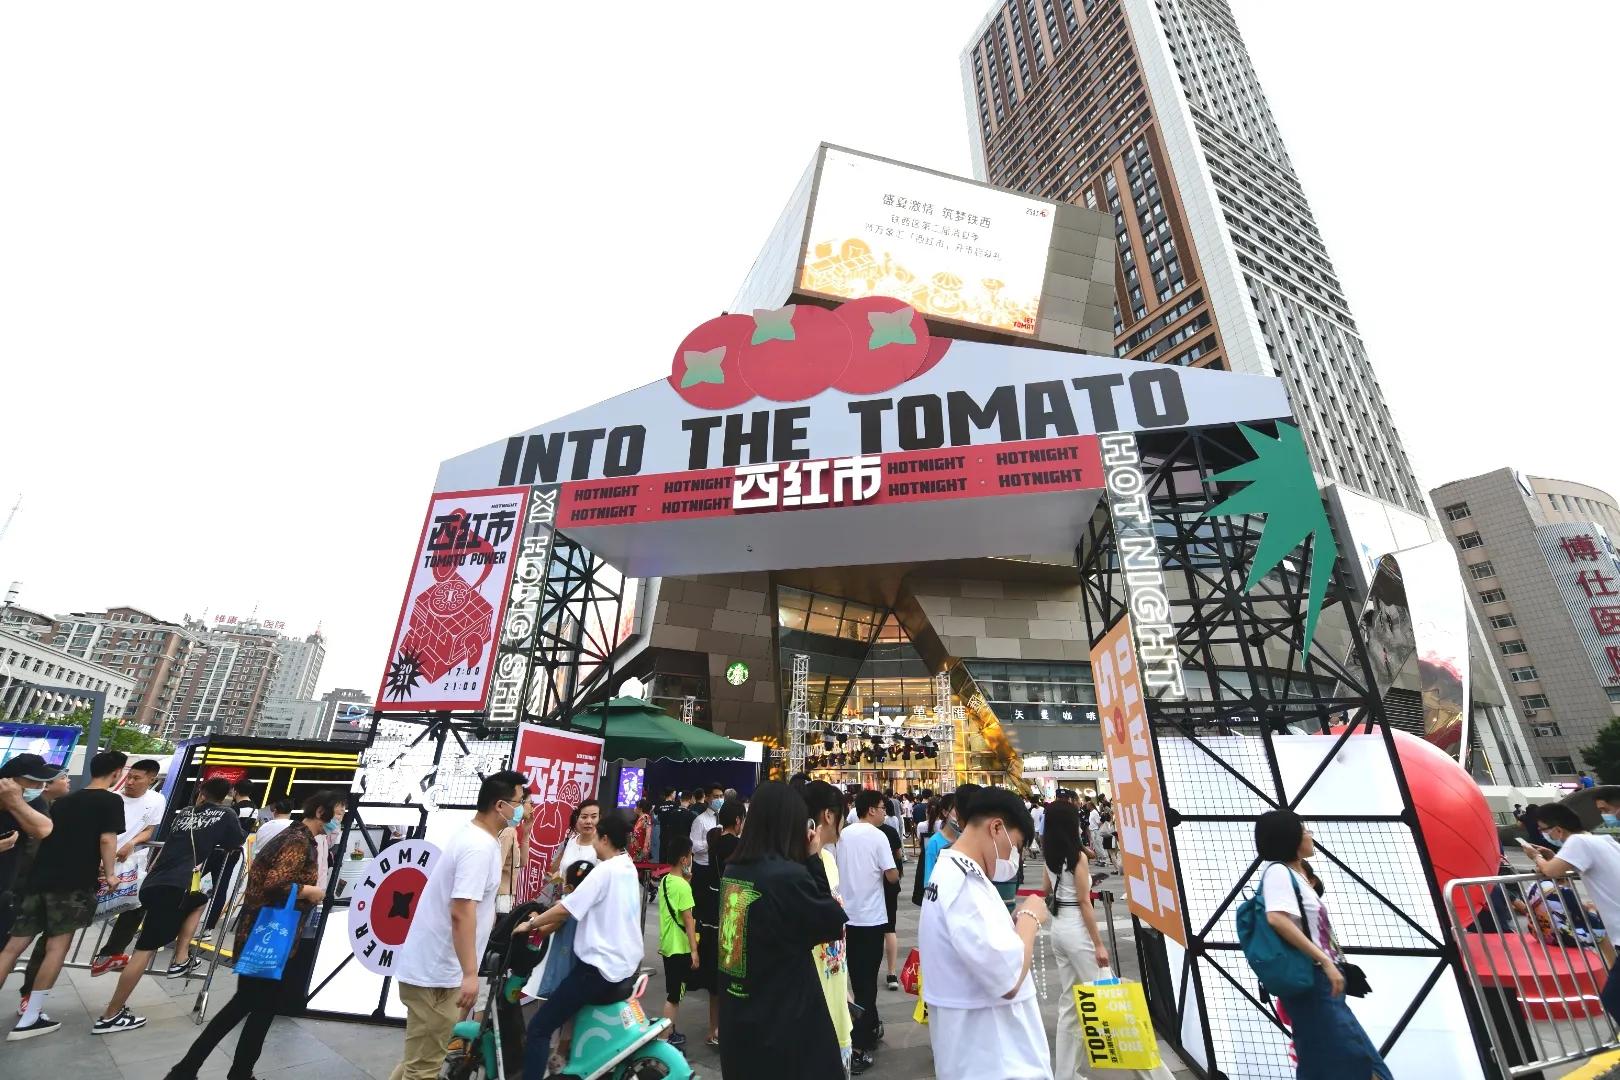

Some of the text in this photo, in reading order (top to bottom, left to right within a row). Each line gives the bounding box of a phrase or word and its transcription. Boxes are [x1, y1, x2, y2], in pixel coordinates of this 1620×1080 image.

[498, 367, 1190, 487] INTO THE TOMATO
[887, 446, 1080, 475] HOTNIGHT HOTNIGHT
[573, 476, 734, 502] HOTNIGHT HOTNIGHT
[732, 455, 882, 511] 西红市
[888, 468, 1083, 497] HOTNIGHT HOTNIGHT
[570, 496, 732, 522] HOTNIGHT HOTNIGHT
[427, 510, 517, 551] 西红市
[424, 551, 507, 569] TOMATO POWER
[1101, 434, 1185, 697] HOT NIGHT
[489, 489, 557, 722] XI HONG SHI
[396, 674, 409, 685] 21
[399, 663, 413, 674] 20
[447, 666, 480, 676] 17:00
[444, 682, 477, 691] 21:00
[1015, 709, 1096, 721] 矢量咖啡
[522, 756, 596, 804] 西红市
[1115, 634, 1176, 918] TOMATO
[364, 848, 430, 889] TOMA
[1078, 990, 1108, 1063] TOPTOY
